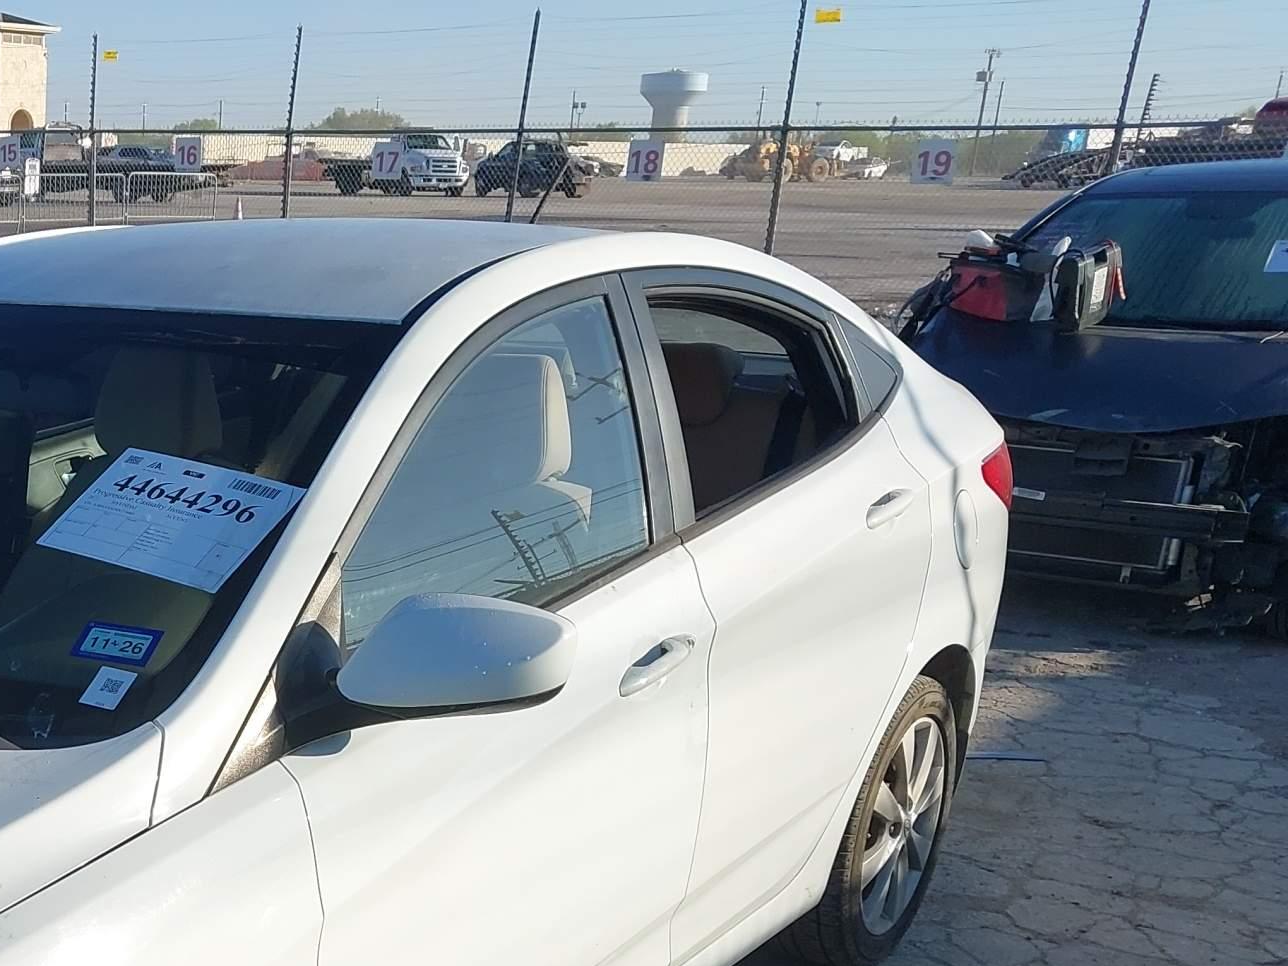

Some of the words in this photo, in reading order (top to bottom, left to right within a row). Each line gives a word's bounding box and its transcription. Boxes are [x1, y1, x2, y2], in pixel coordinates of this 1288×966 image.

[0, 143, 17, 163] 15
[178, 145, 198, 166] 16
[376, 151, 400, 174] 17
[630, 149, 660, 175] 18
[917, 149, 953, 177] 19
[93, 487, 135, 503] Progressive
[135, 496, 166, 511] Casualty
[113, 474, 265, 524] 44644296
